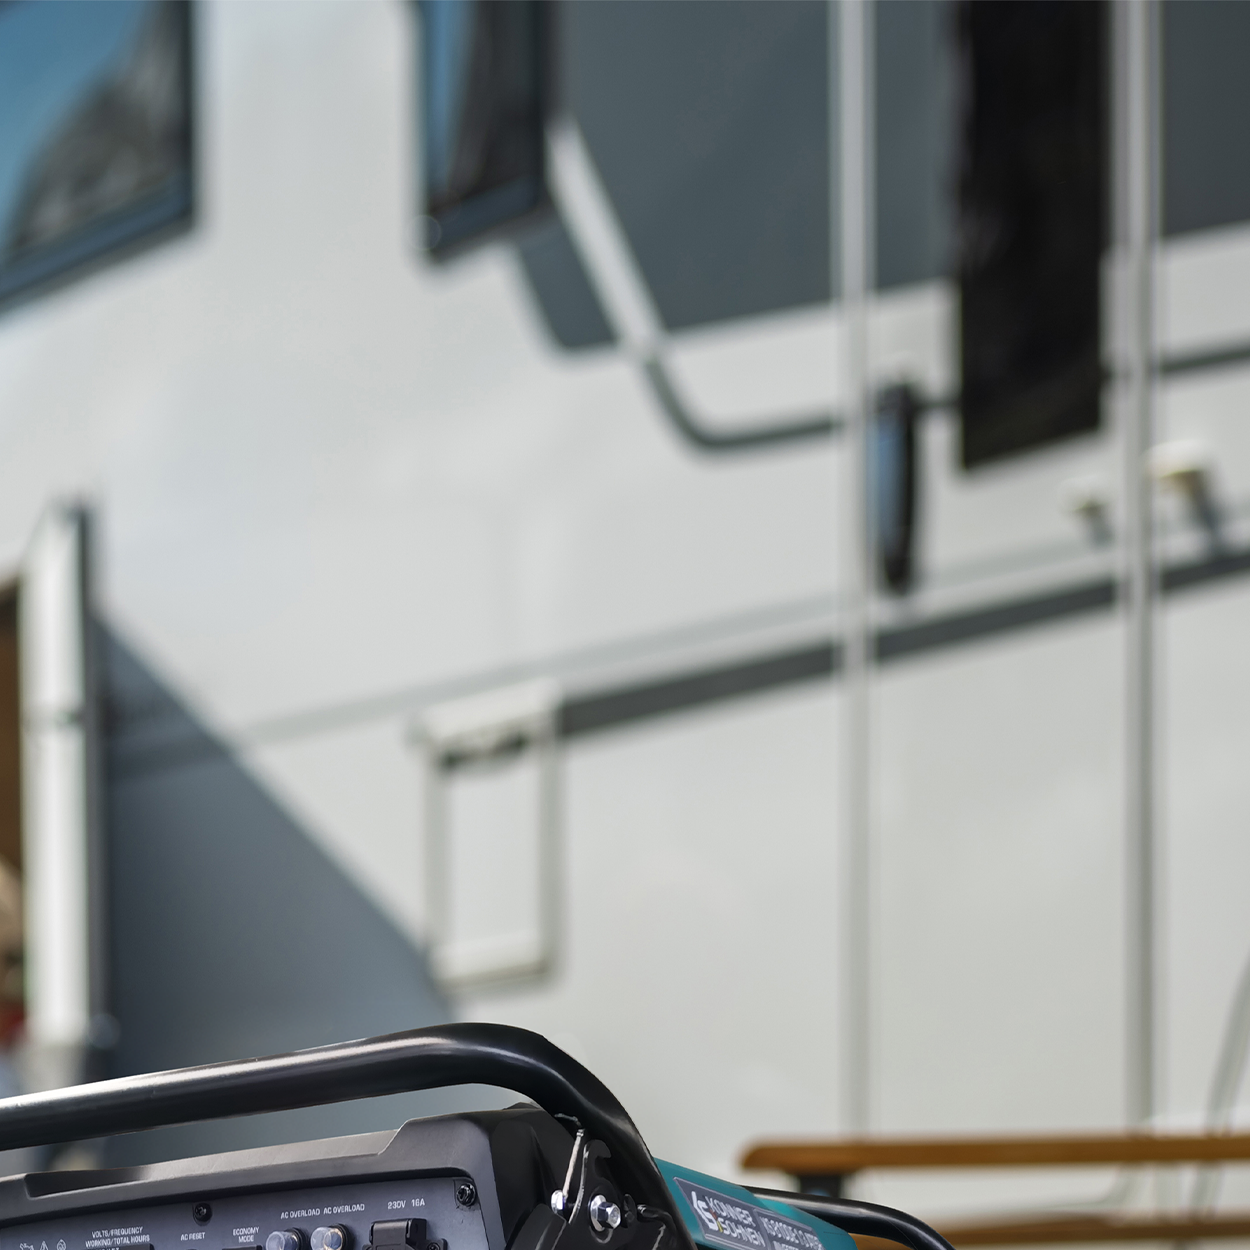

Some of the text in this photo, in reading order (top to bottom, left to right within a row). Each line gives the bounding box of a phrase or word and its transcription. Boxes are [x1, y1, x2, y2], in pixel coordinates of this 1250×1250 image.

[333, 1204, 366, 1214] OVERLOAD
[388, 1200, 406, 1210] 230V
[281, 1208, 320, 1220] AC OVERLOAD
[92, 1226, 143, 1238] VOLTS/FREQUENCY
[188, 1232, 206, 1240] RESET
[233, 1227, 260, 1236] ECONOMY
[131, 1234, 150, 1243] HOURS
